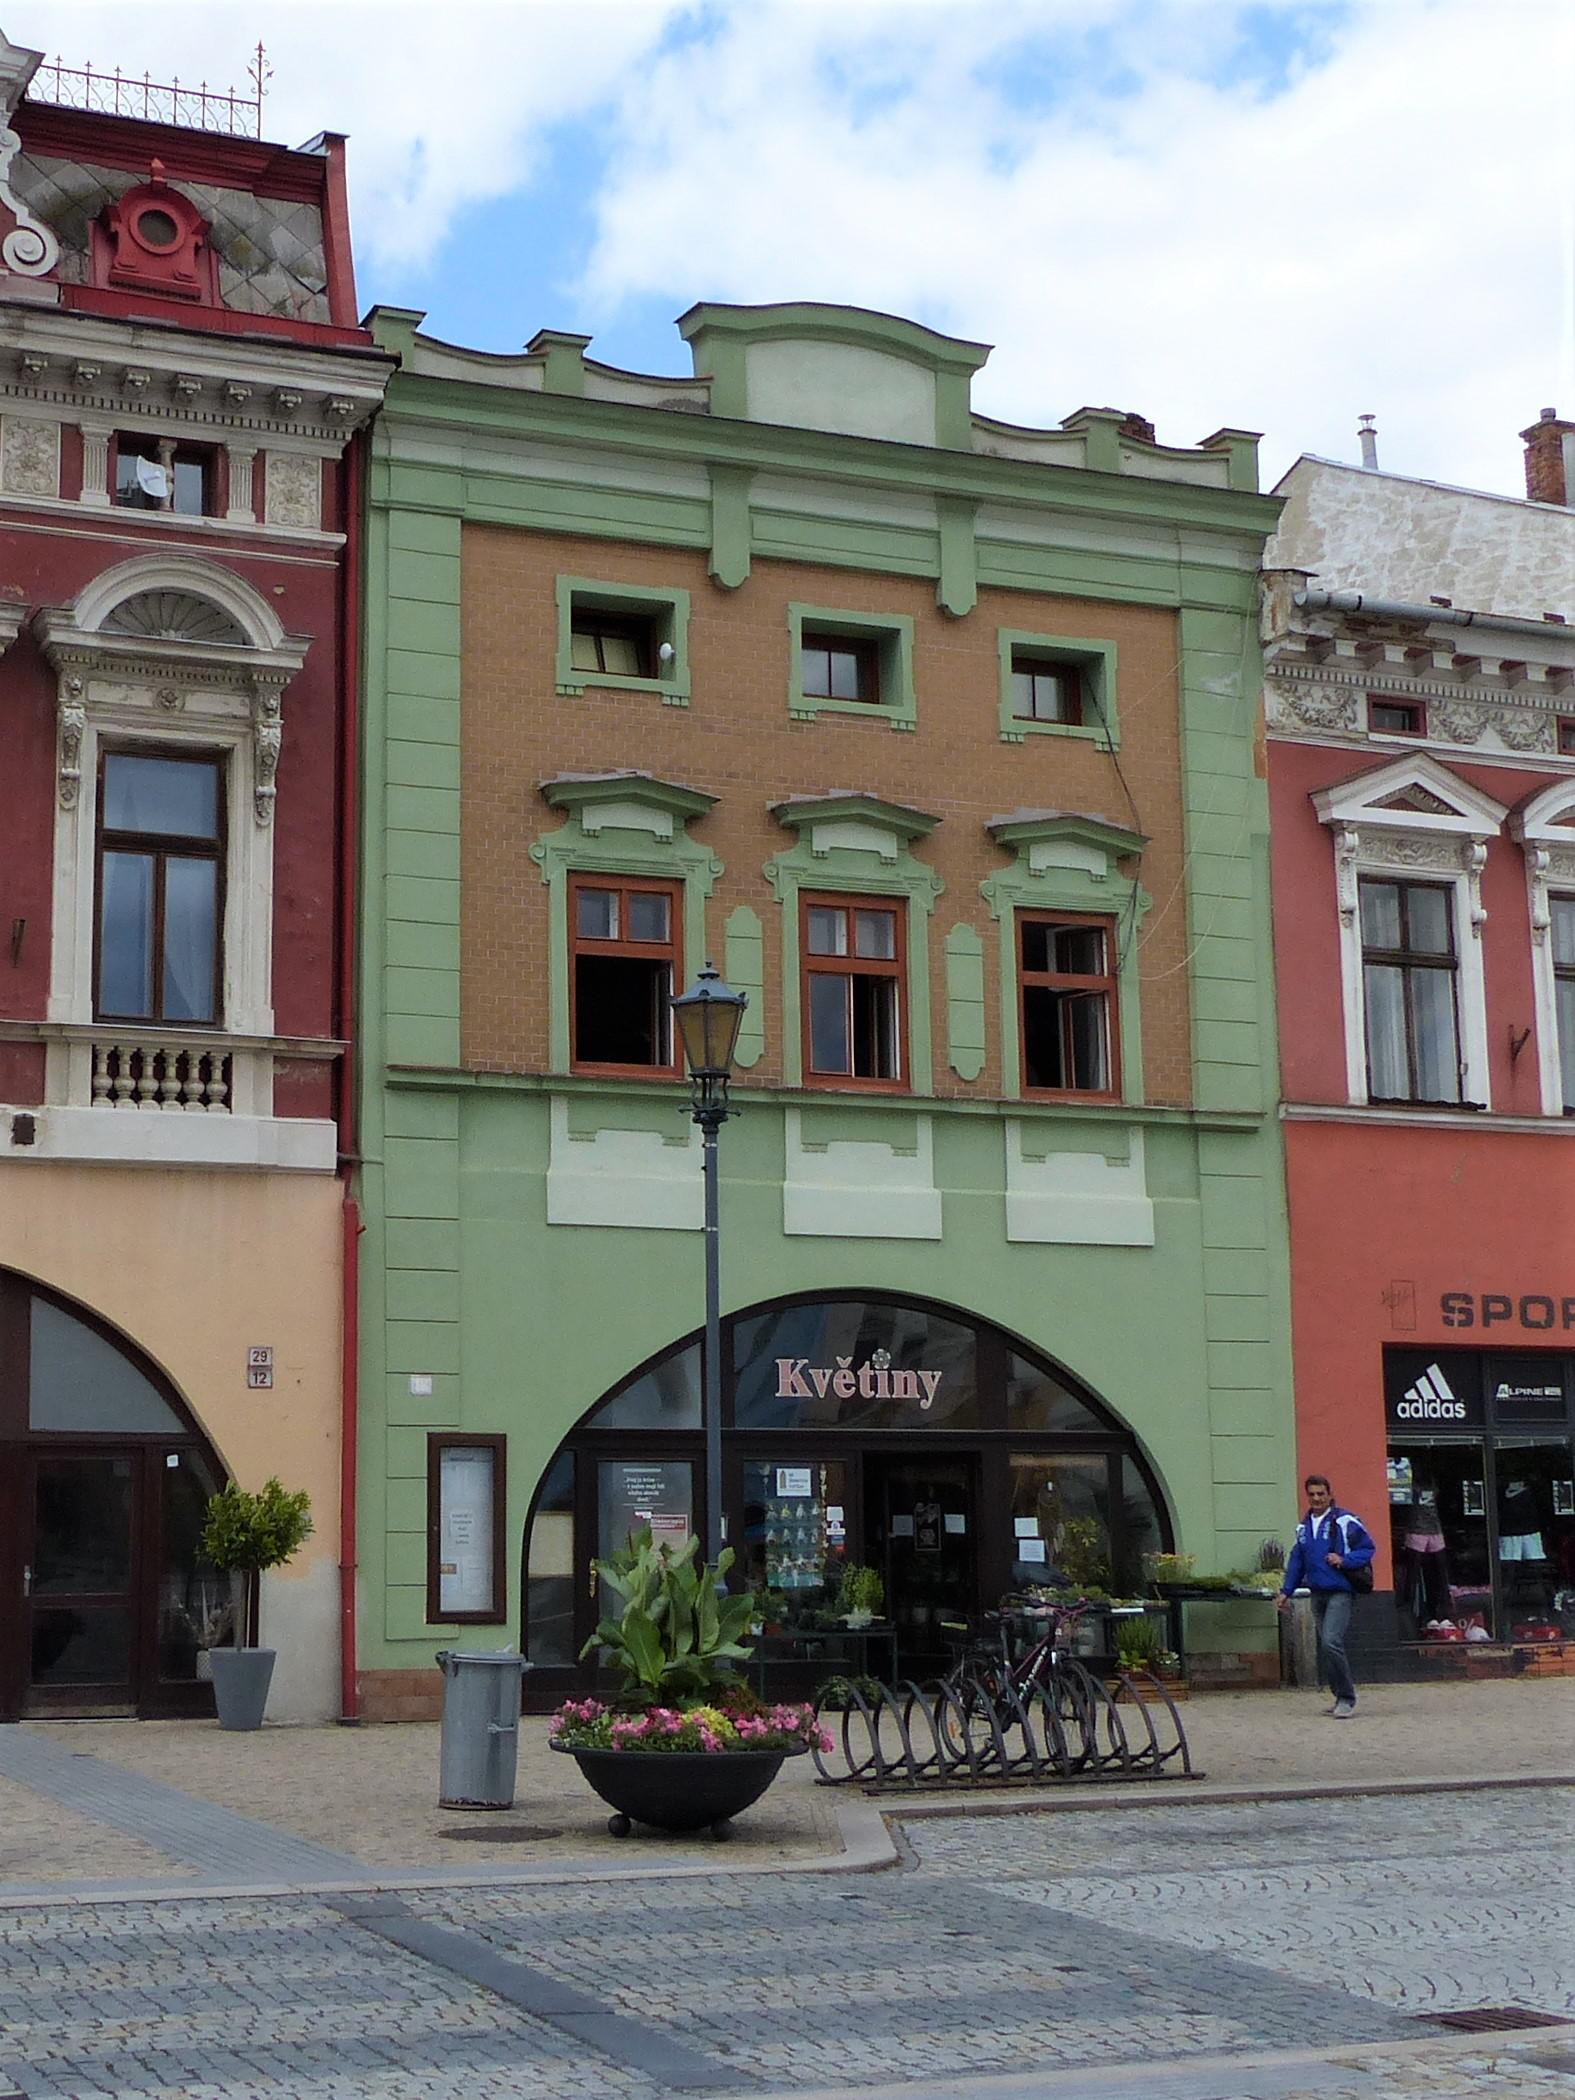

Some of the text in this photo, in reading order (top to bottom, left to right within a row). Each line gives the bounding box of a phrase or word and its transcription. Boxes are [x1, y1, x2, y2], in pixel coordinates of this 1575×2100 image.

[253, 1351, 267, 1362] 29
[253, 1372, 267, 1384] 12
[775, 1353, 942, 1409] Květiny
[1396, 1399, 1467, 1419] adidas
